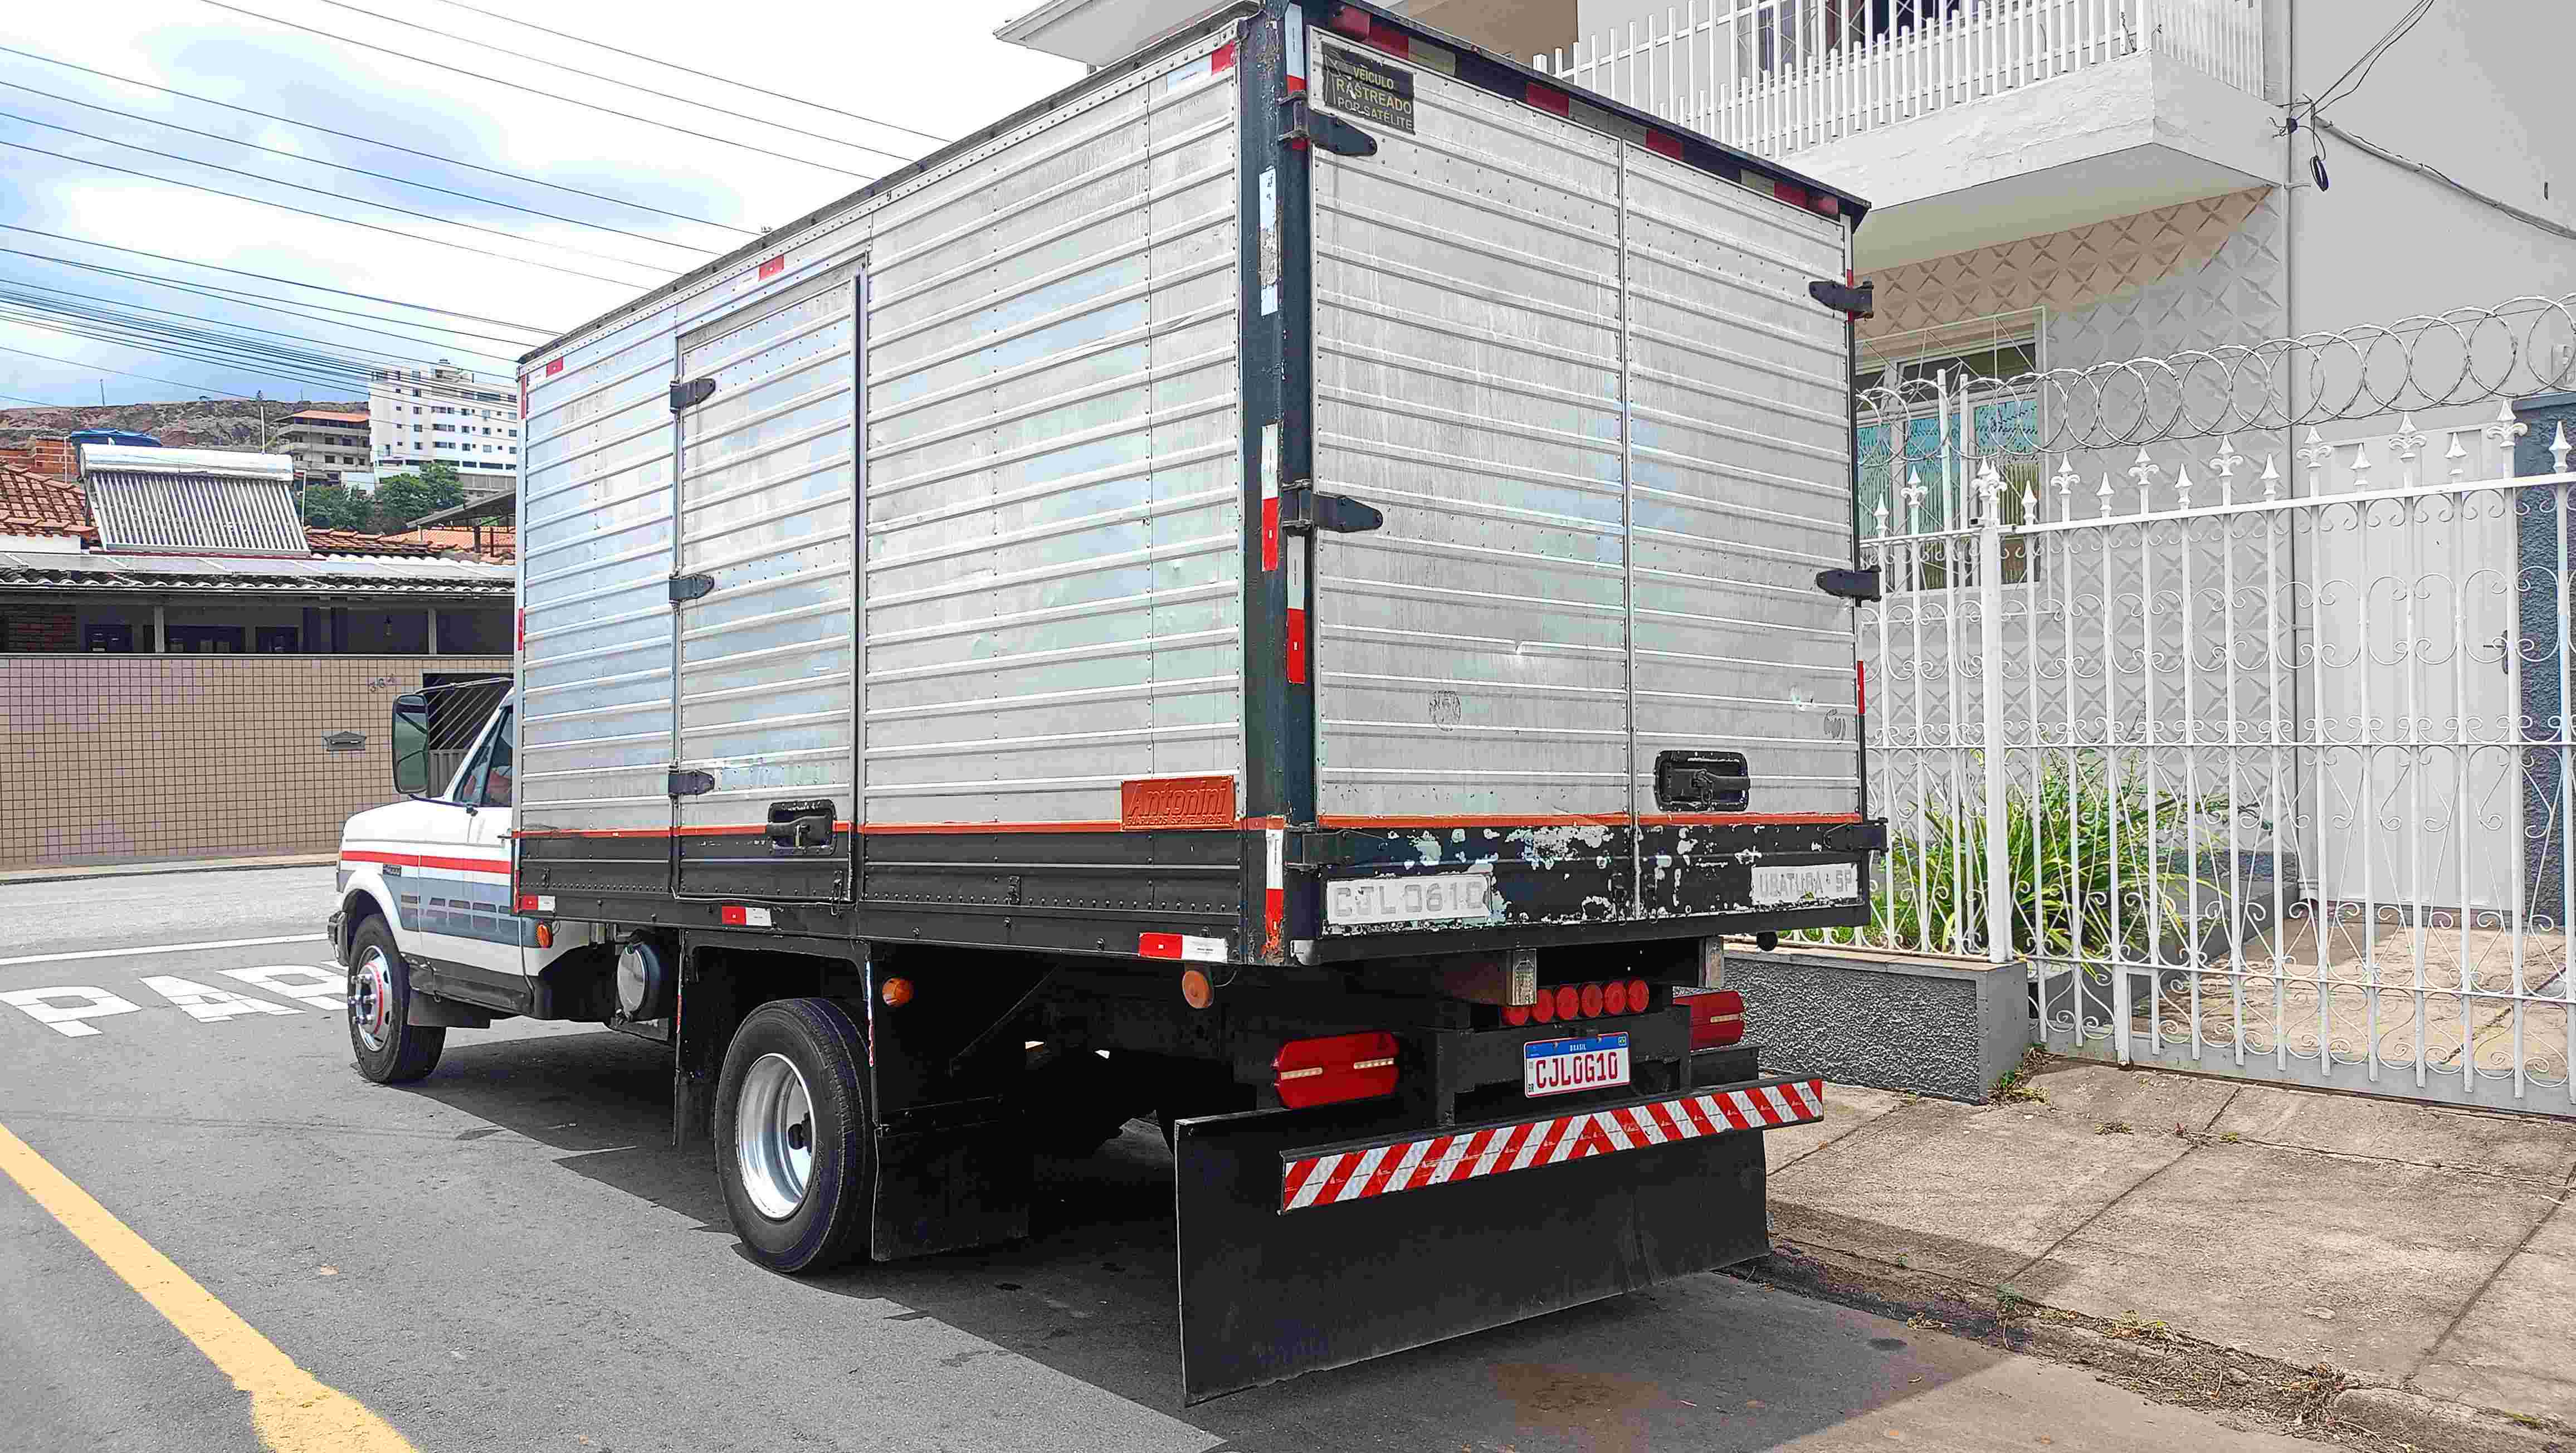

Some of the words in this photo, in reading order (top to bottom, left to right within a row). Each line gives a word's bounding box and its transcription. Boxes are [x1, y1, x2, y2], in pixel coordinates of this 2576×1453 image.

[1337, 79, 1412, 115] RASTREADO
[1338, 96, 1360, 110] POR
[1128, 779, 1227, 816] Antonini
[1570, 1043, 1587, 1052] BRASIL
